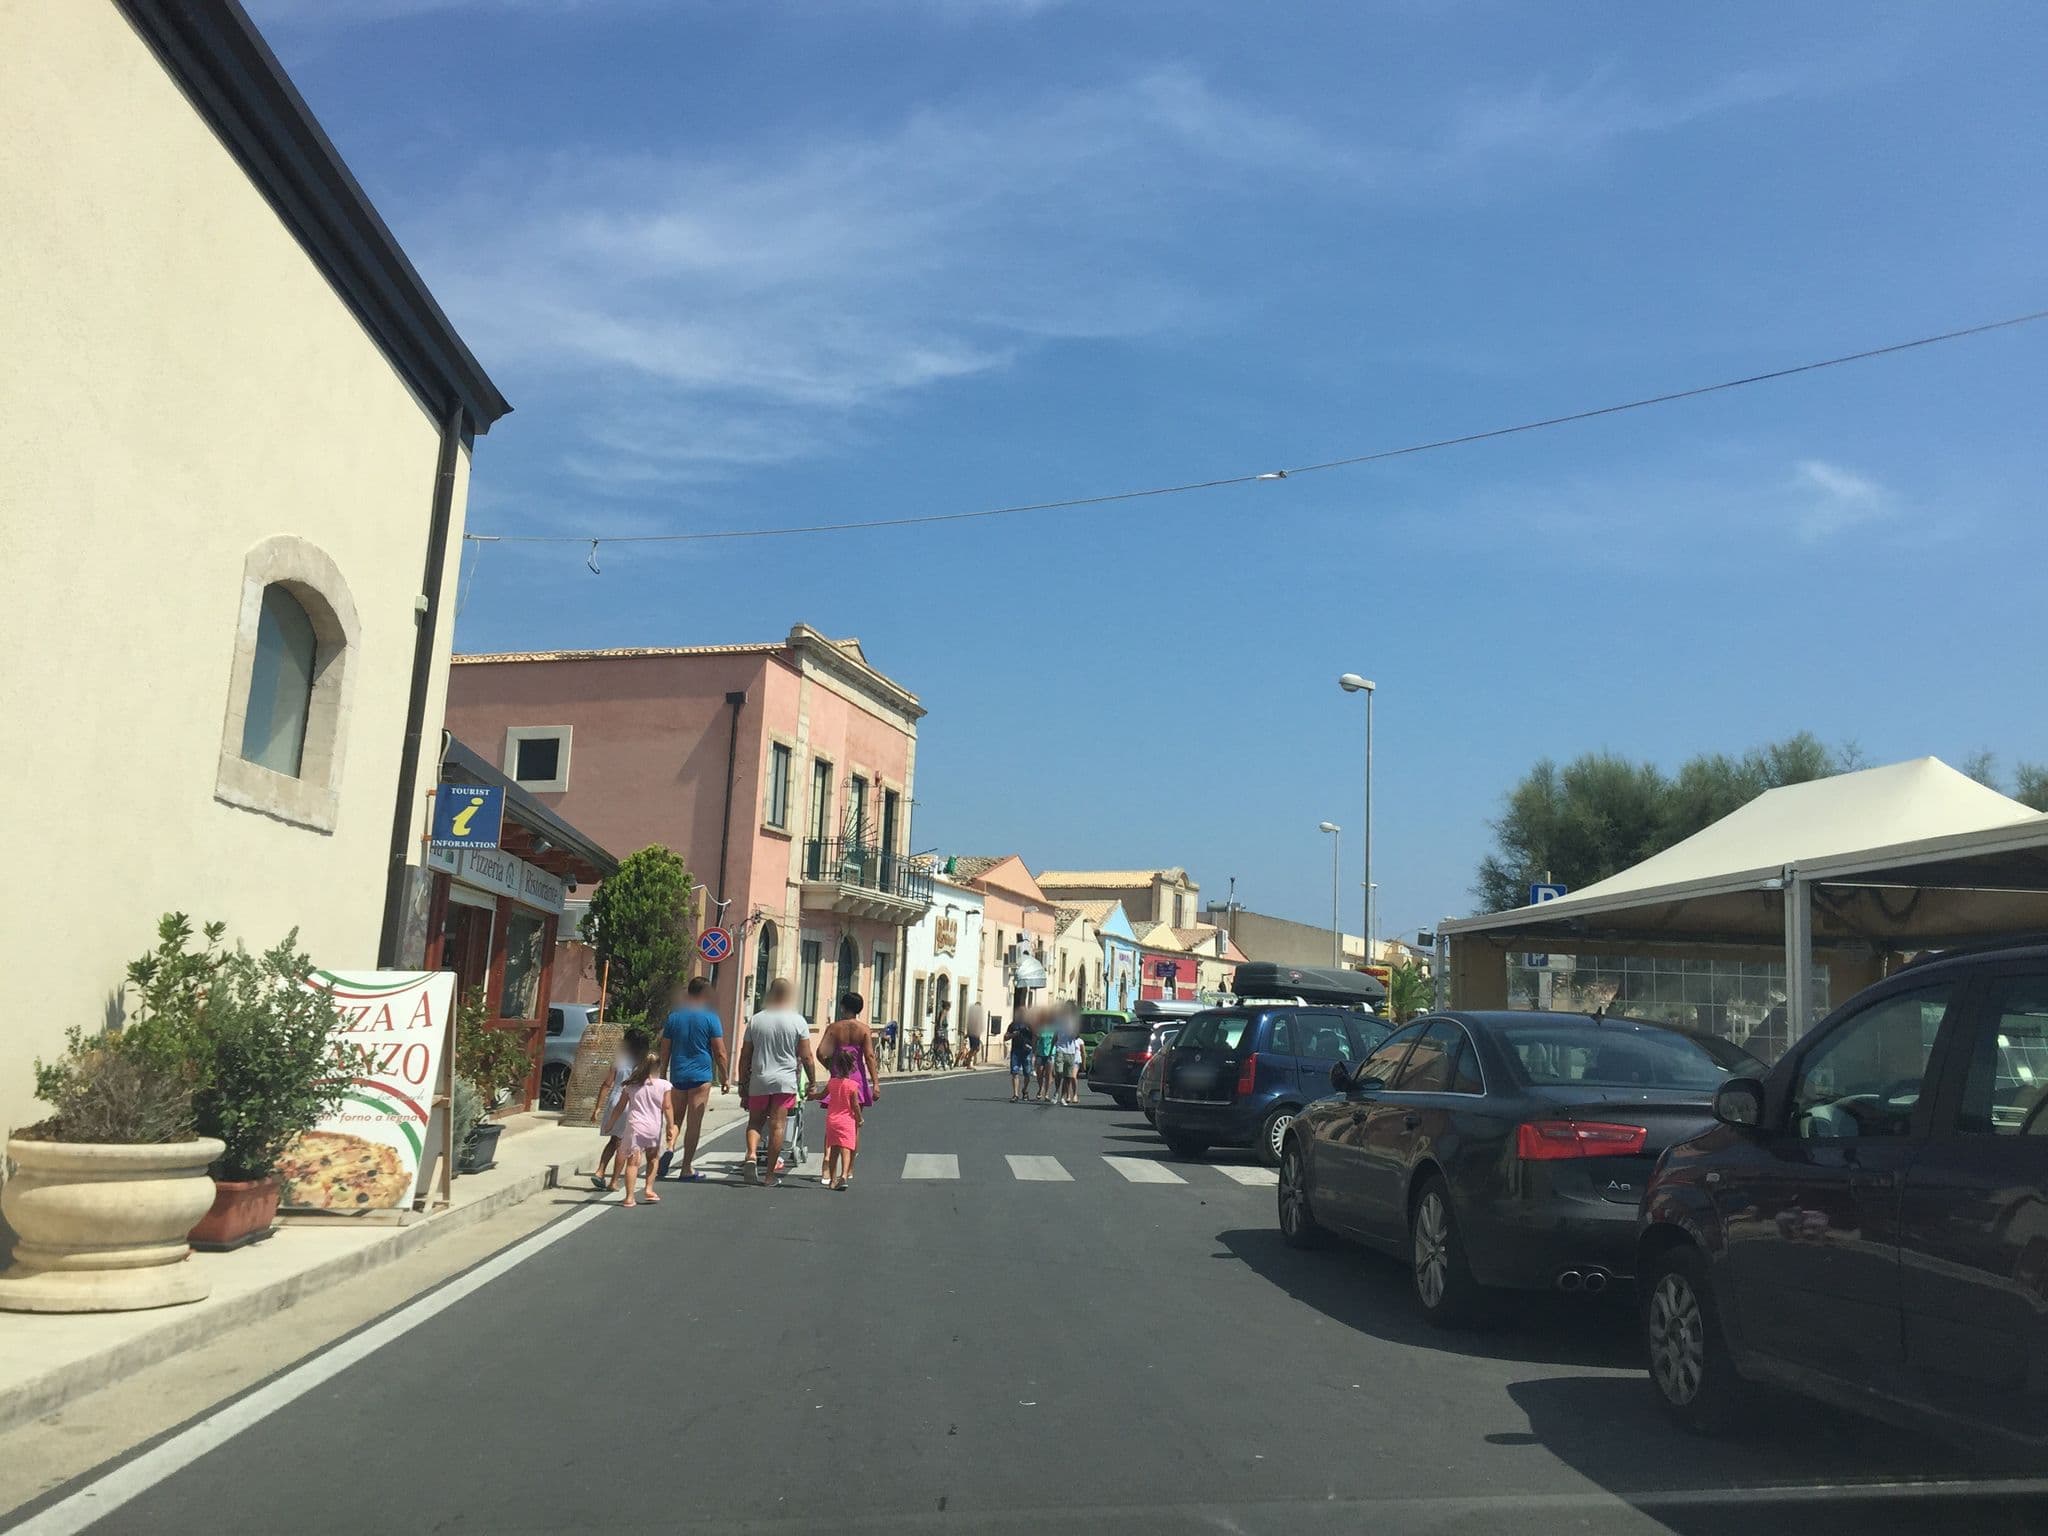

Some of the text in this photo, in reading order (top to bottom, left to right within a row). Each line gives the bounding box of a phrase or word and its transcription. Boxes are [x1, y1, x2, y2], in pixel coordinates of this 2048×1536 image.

[451, 787, 491, 796] TOURIST
[452, 797, 484, 837] i
[432, 839, 497, 849] INFORMATION
[470, 850, 504, 882] Pizzeria
[525, 869, 558, 904] Ristorante
[1537, 887, 1560, 905] P
[329, 990, 433, 1033] ZZA A
[339, 1113, 372, 1123] forno
[386, 1113, 418, 1125] legna
